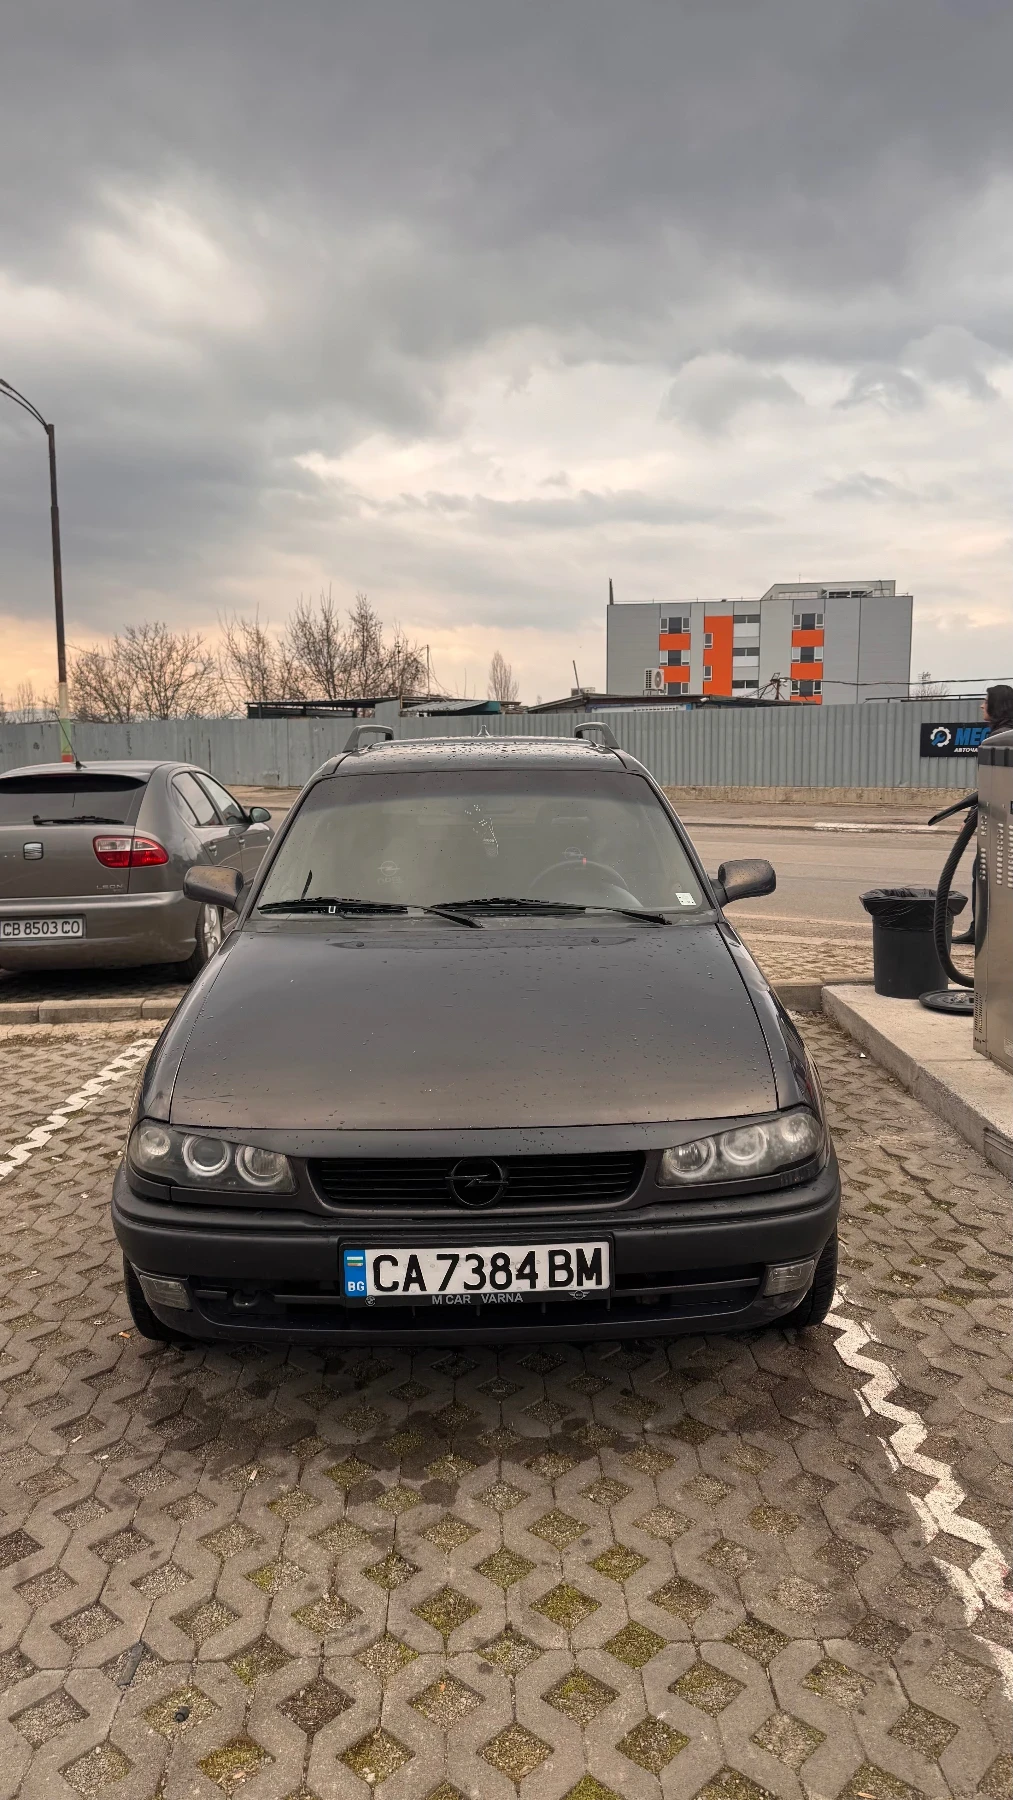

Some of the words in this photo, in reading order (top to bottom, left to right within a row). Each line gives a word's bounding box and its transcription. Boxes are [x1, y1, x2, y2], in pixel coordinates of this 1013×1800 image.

[3, 922, 21, 936] CB
[24, 921, 58, 935] 8503
[61, 920, 80, 934] CO
[372, 1254, 427, 1292] CA
[436, 1250, 539, 1292] 7384
[548, 1247, 603, 1287] BM
[347, 1281, 365, 1292] BG
[445, 1294, 471, 1305] CAR
[481, 1293, 523, 1304] VARNA
